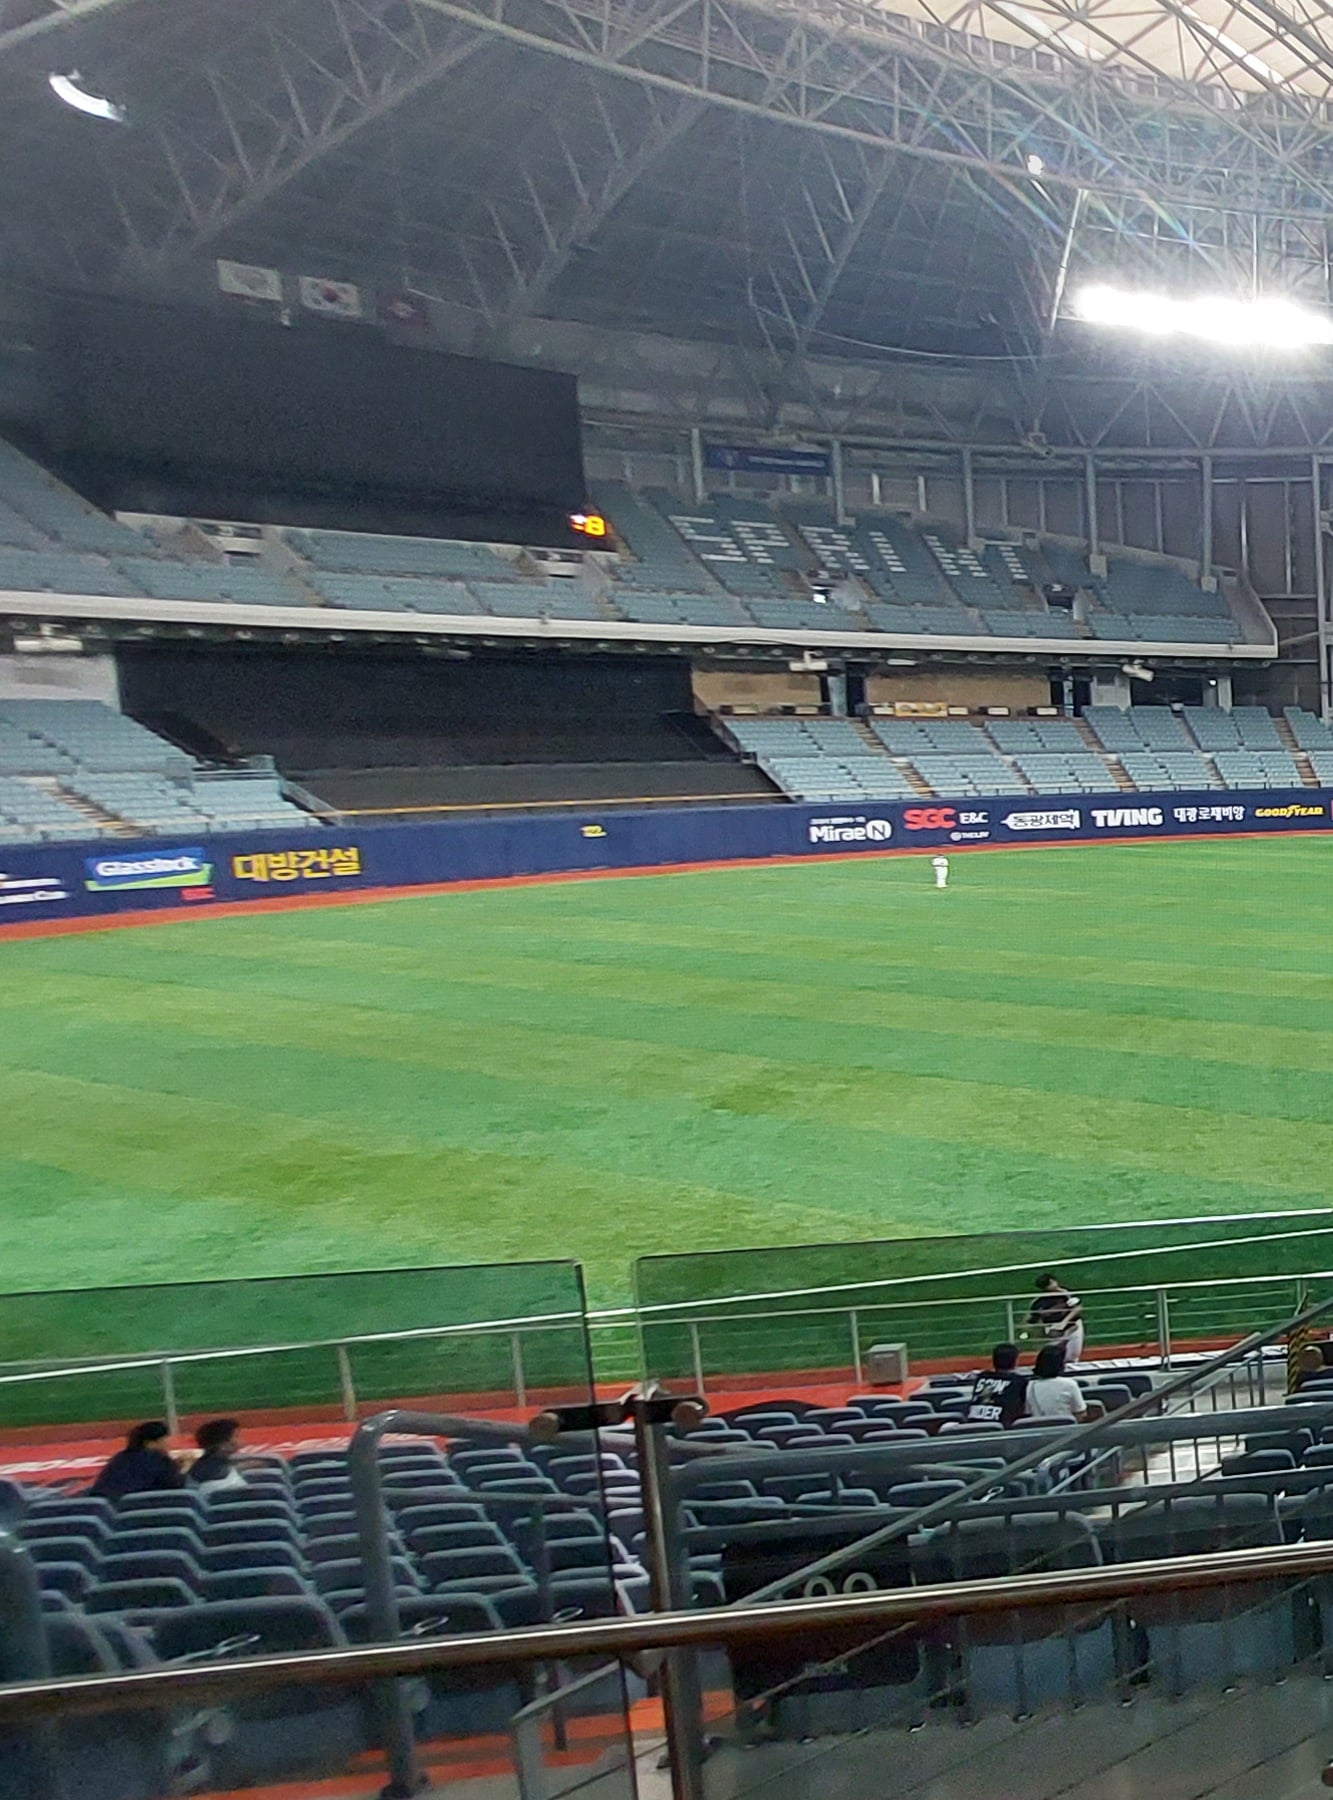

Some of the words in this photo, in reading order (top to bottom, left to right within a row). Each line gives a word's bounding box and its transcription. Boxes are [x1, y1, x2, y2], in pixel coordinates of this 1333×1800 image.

[904, 808, 956, 829] SGC
[960, 812, 989, 823] E&C
[1092, 809, 1164, 827] TVING
[1255, 805, 1323, 818] GOODYEAR
[232, 847, 361, 881] 대방건설
